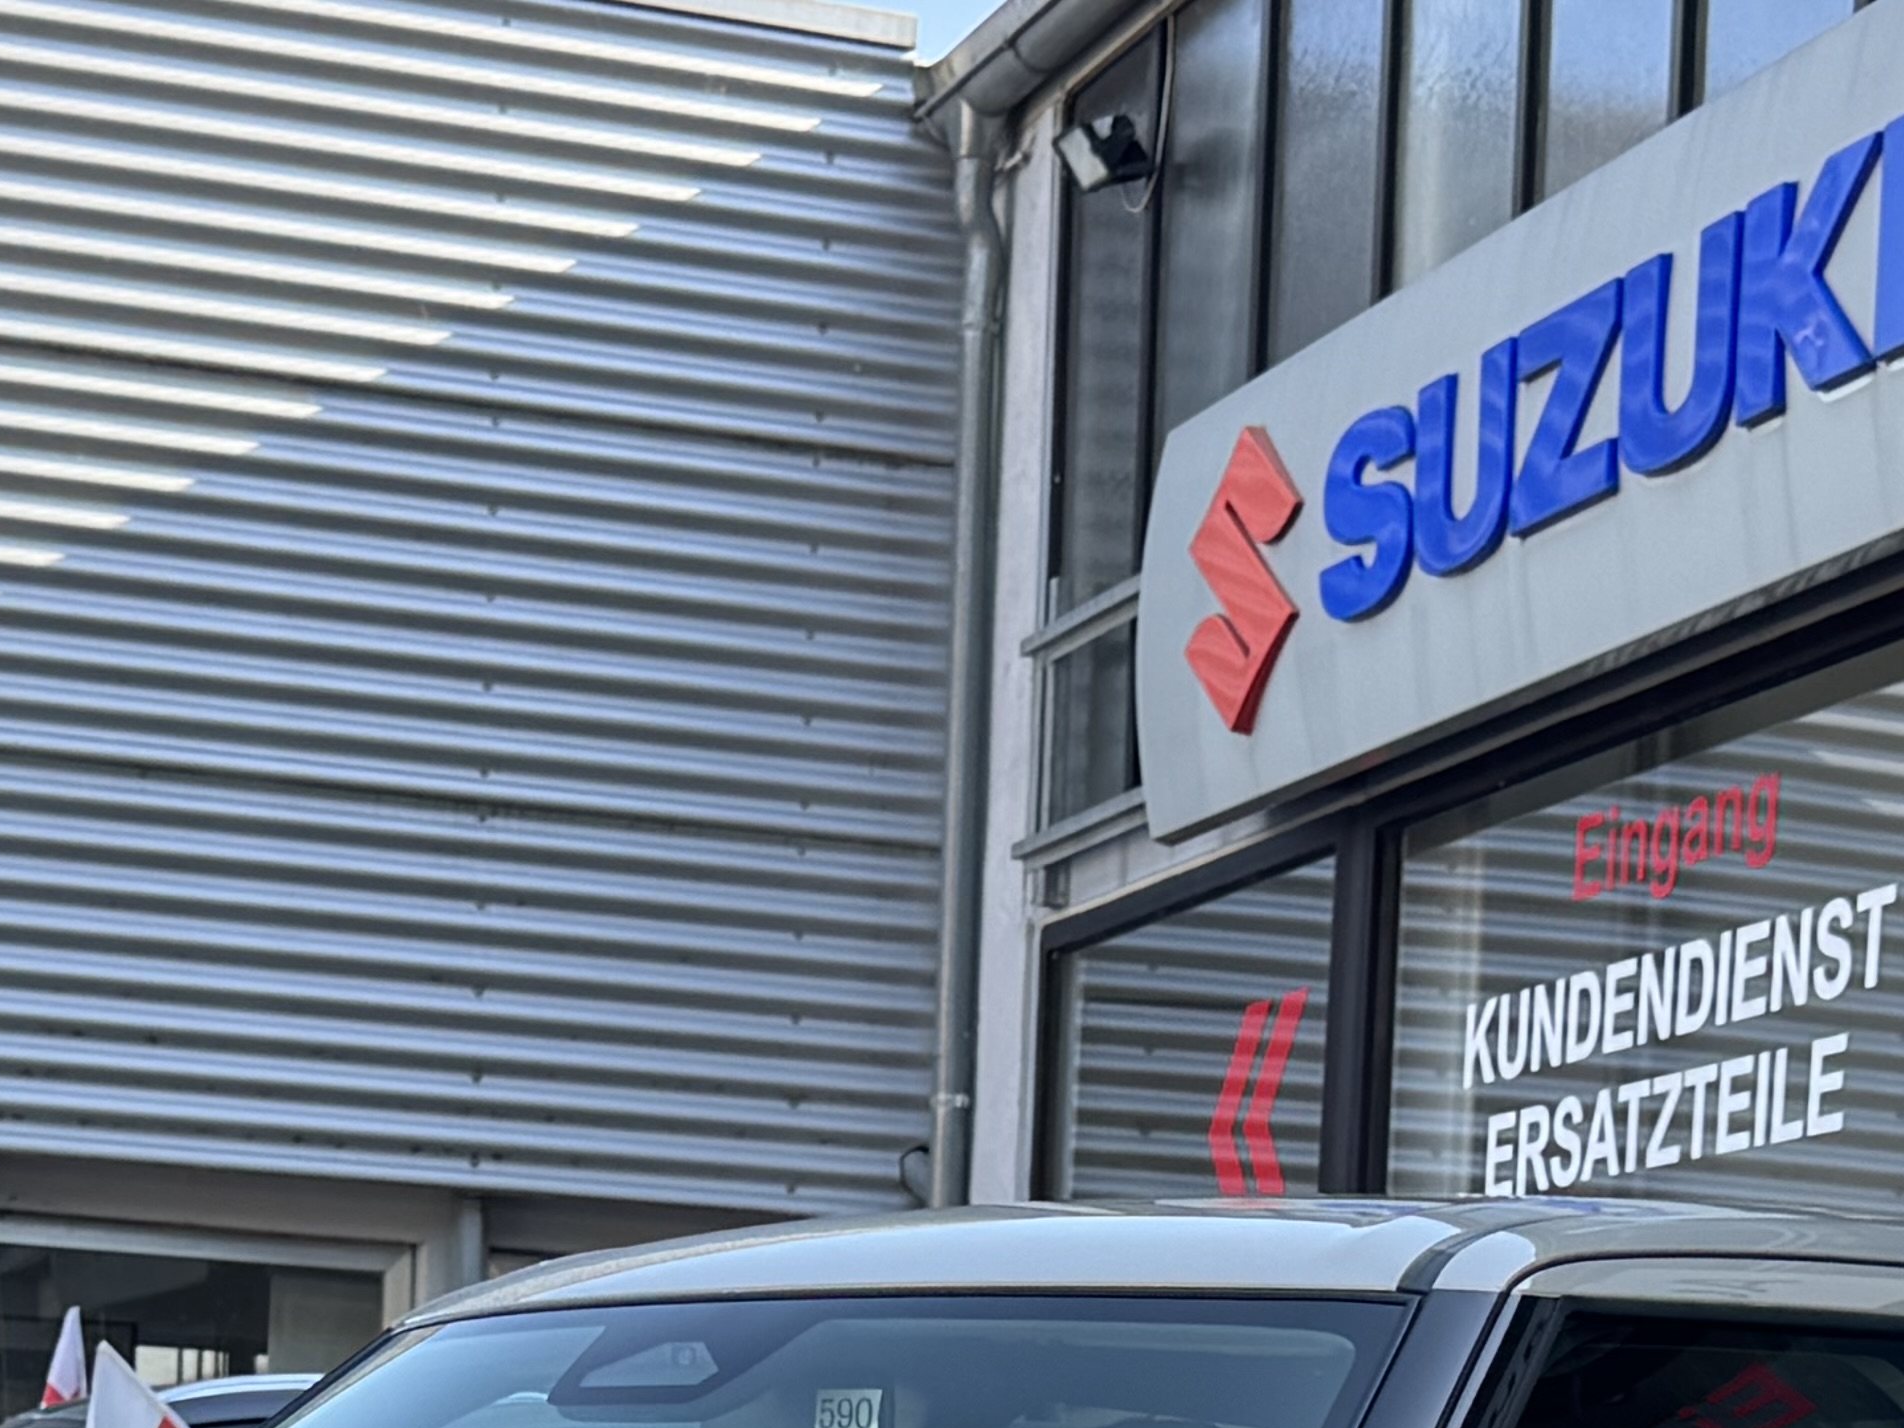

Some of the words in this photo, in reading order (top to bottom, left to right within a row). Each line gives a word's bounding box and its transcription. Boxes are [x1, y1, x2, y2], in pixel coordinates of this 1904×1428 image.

[1571, 772, 1781, 902] Eingang
[1462, 882, 1898, 1092] KUNDENDIENST
[1483, 1032, 1850, 1199] ERSATZTEILE
